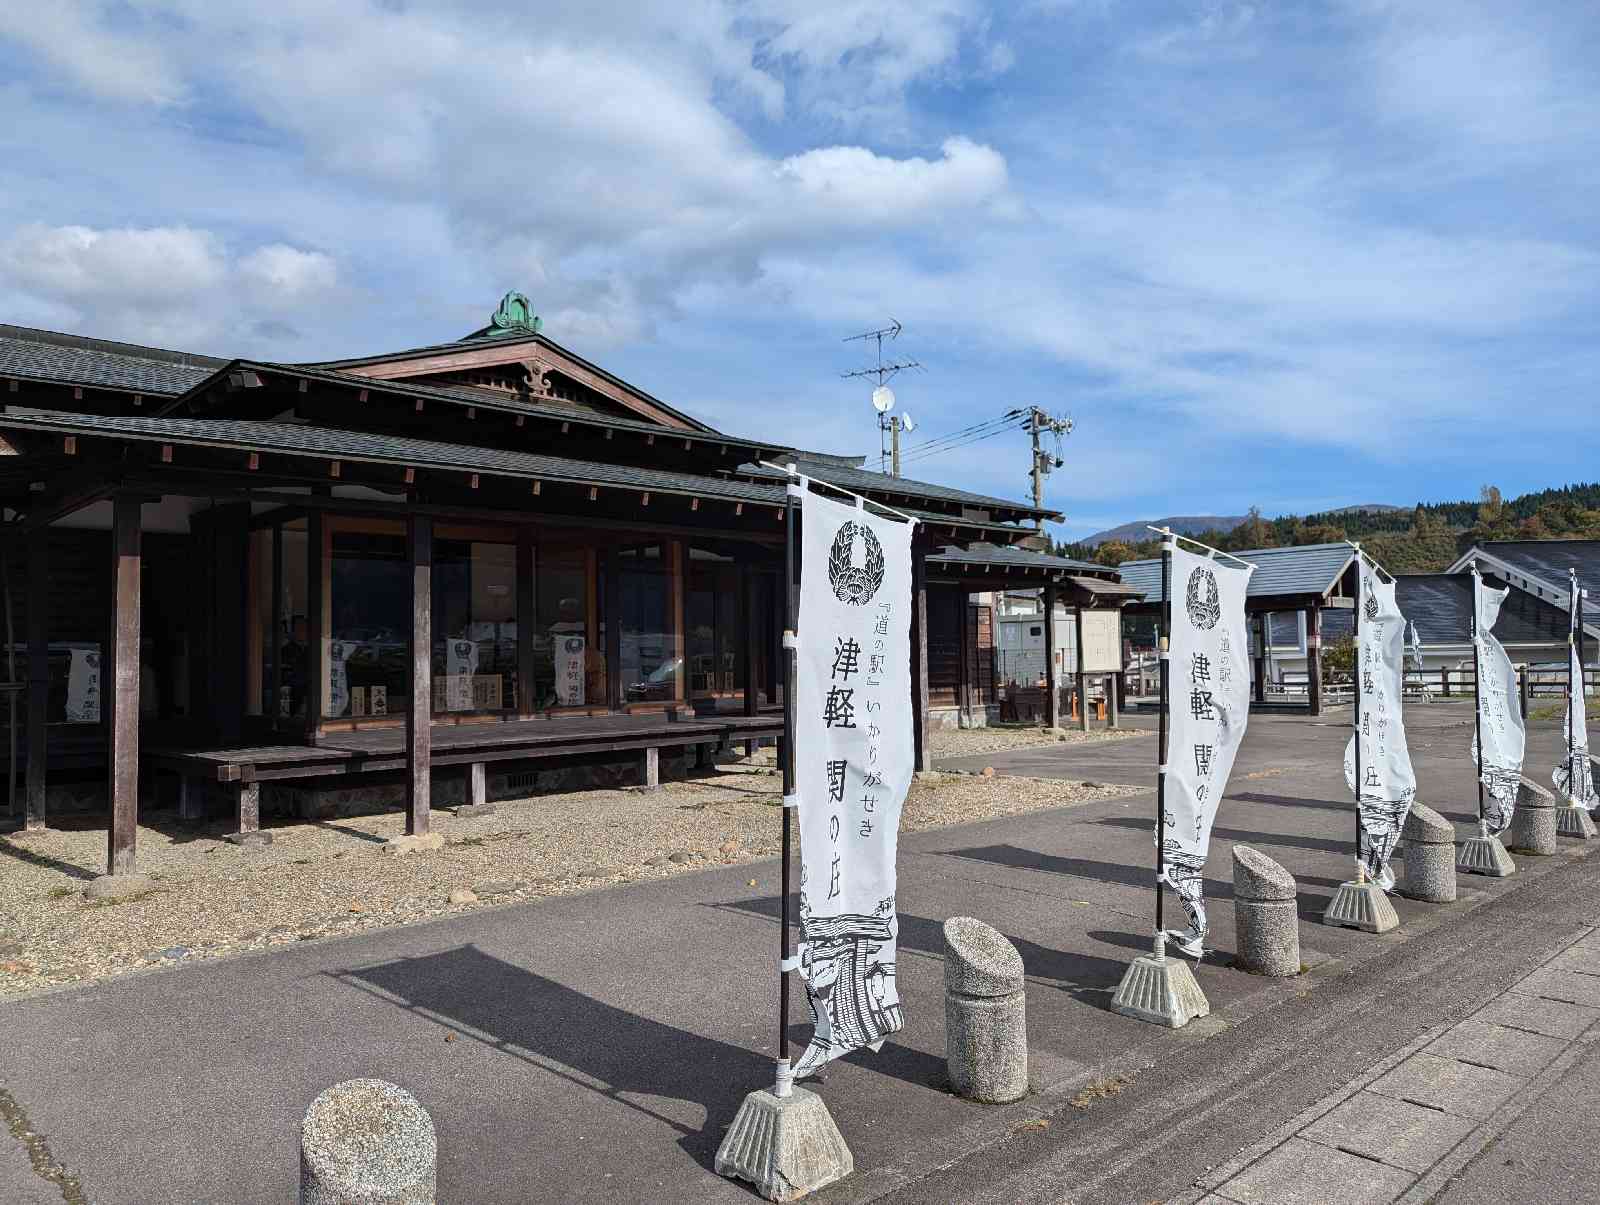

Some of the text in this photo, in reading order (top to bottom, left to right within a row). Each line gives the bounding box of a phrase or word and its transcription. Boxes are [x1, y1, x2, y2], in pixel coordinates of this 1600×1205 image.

[858, 602, 892, 837] 『道の駅』いかりがせき
